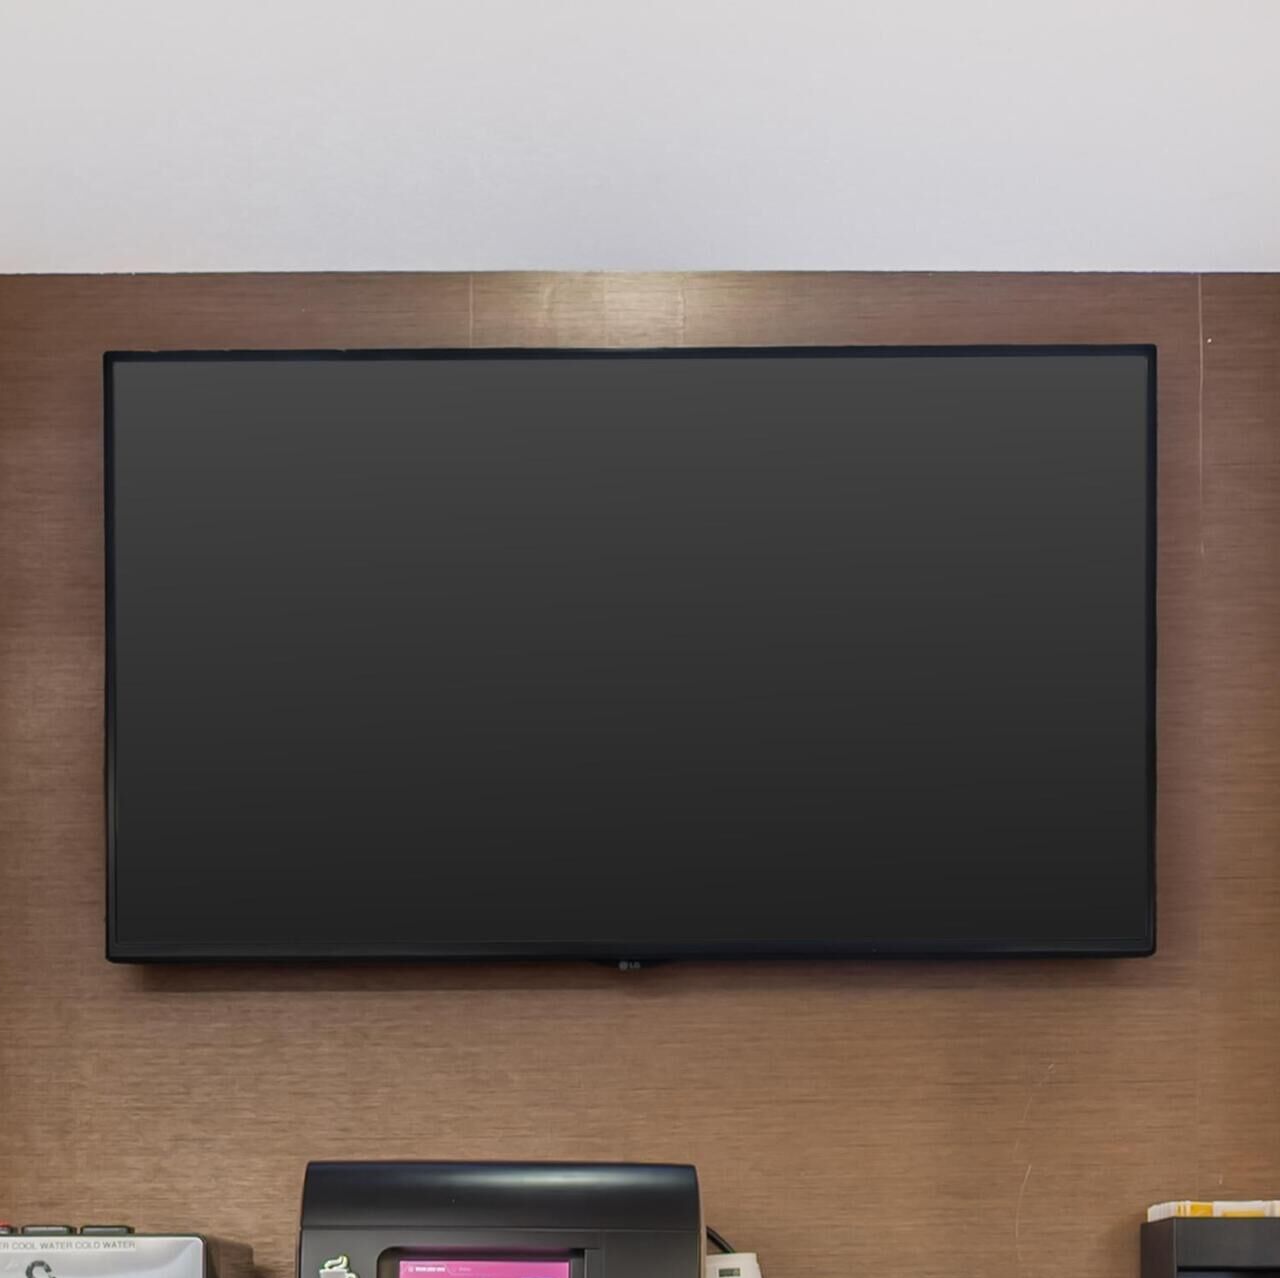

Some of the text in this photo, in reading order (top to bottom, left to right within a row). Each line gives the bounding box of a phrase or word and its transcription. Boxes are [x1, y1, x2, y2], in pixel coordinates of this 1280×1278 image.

[12, 1242, 36, 1250] COOL
[40, 1242, 73, 1250] WATER
[75, 1241, 101, 1249] COLD
[102, 1241, 136, 1249] WATER
